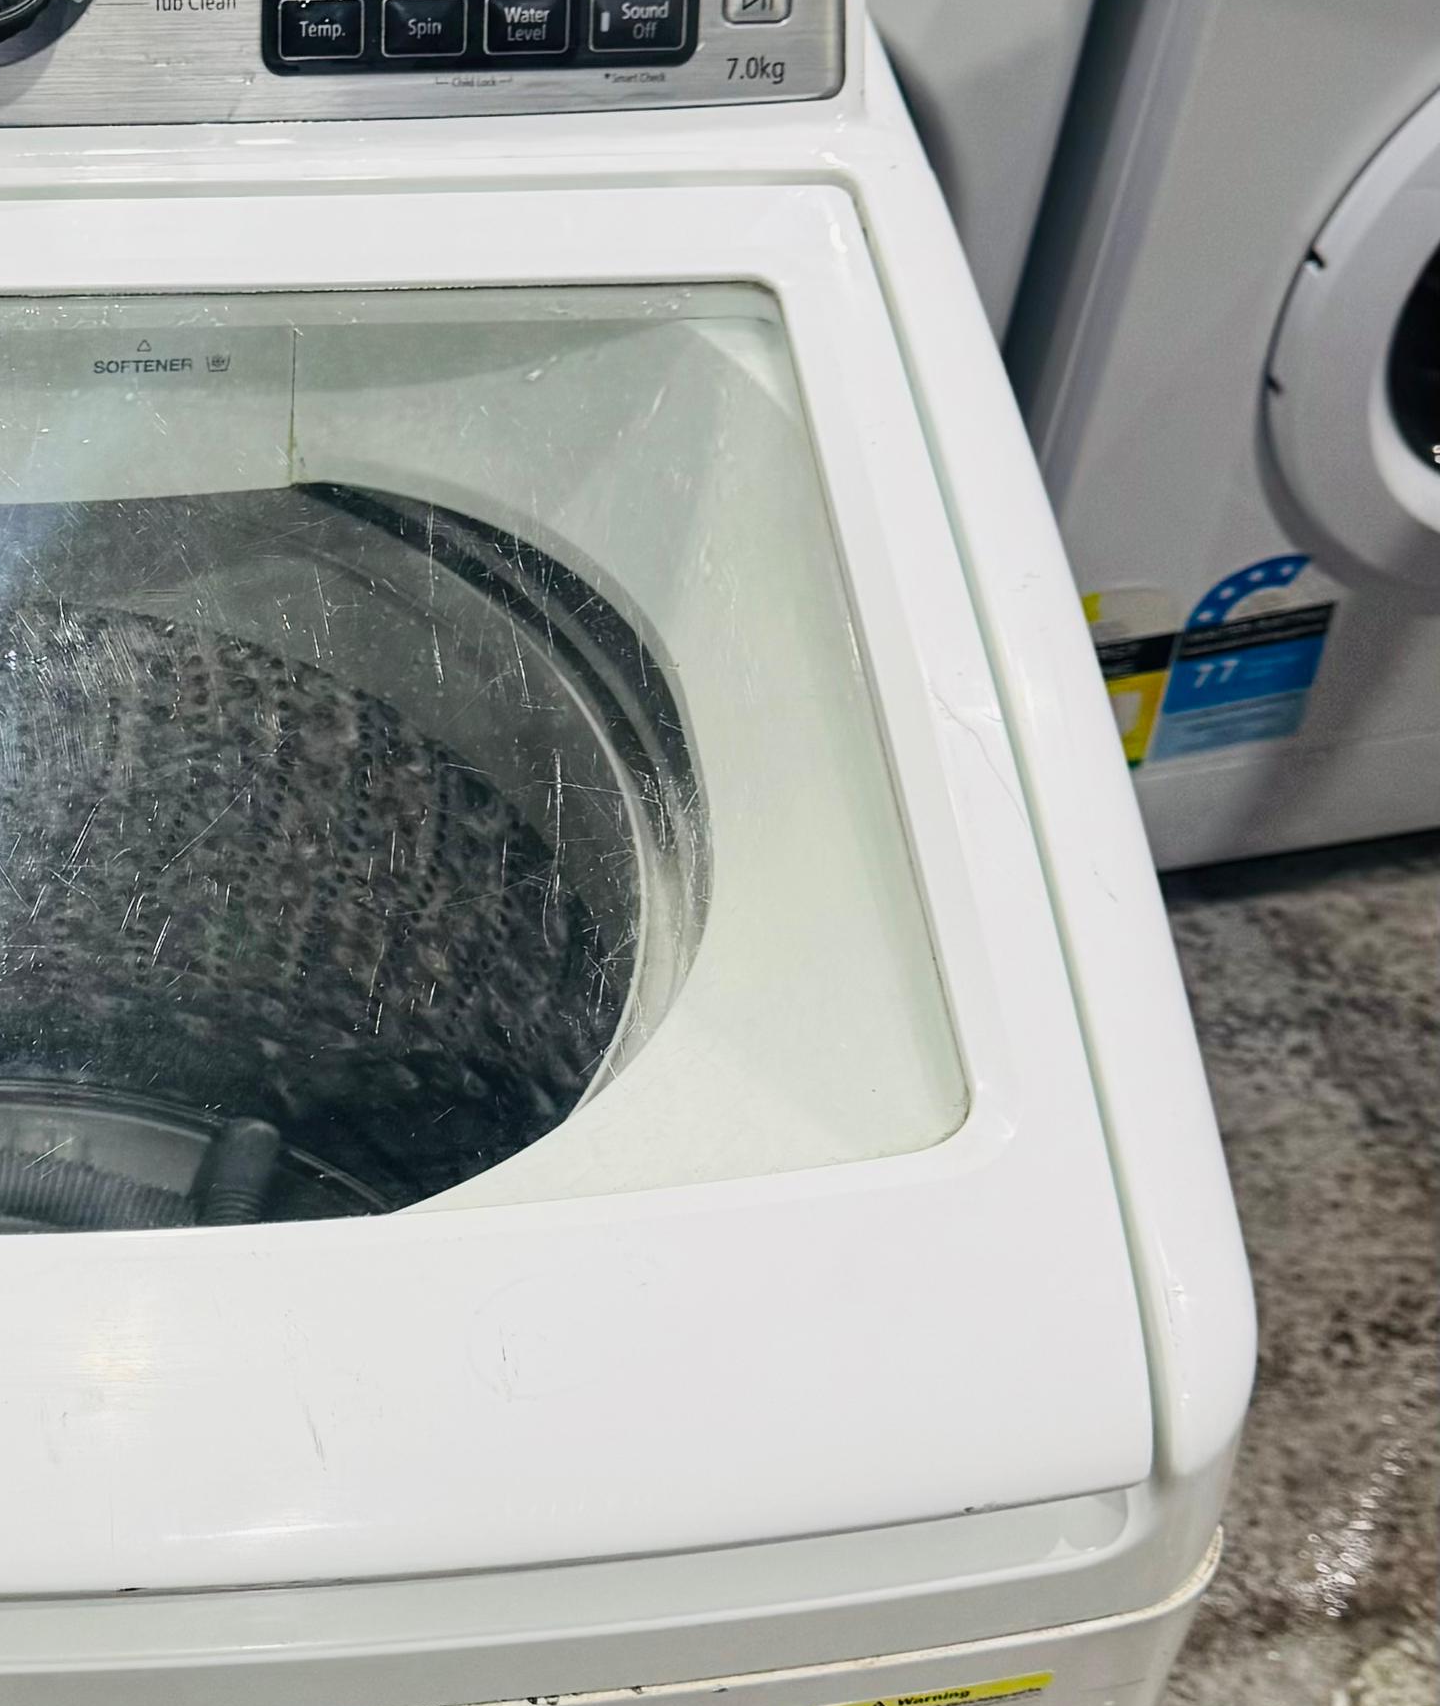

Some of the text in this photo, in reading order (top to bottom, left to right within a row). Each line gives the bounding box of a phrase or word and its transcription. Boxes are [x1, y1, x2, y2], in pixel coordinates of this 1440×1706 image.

[503, 5, 551, 25] Water
[621, 0, 670, 20] Sound
[299, 21, 346, 41] Temp.
[407, 18, 442, 40] Spin
[507, 24, 547, 42] Level
[632, 22, 658, 40] Off
[726, 56, 786, 86] 7.0kg
[93, 358, 194, 374] SOFTENER
[897, 1690, 971, 1706] Warning
